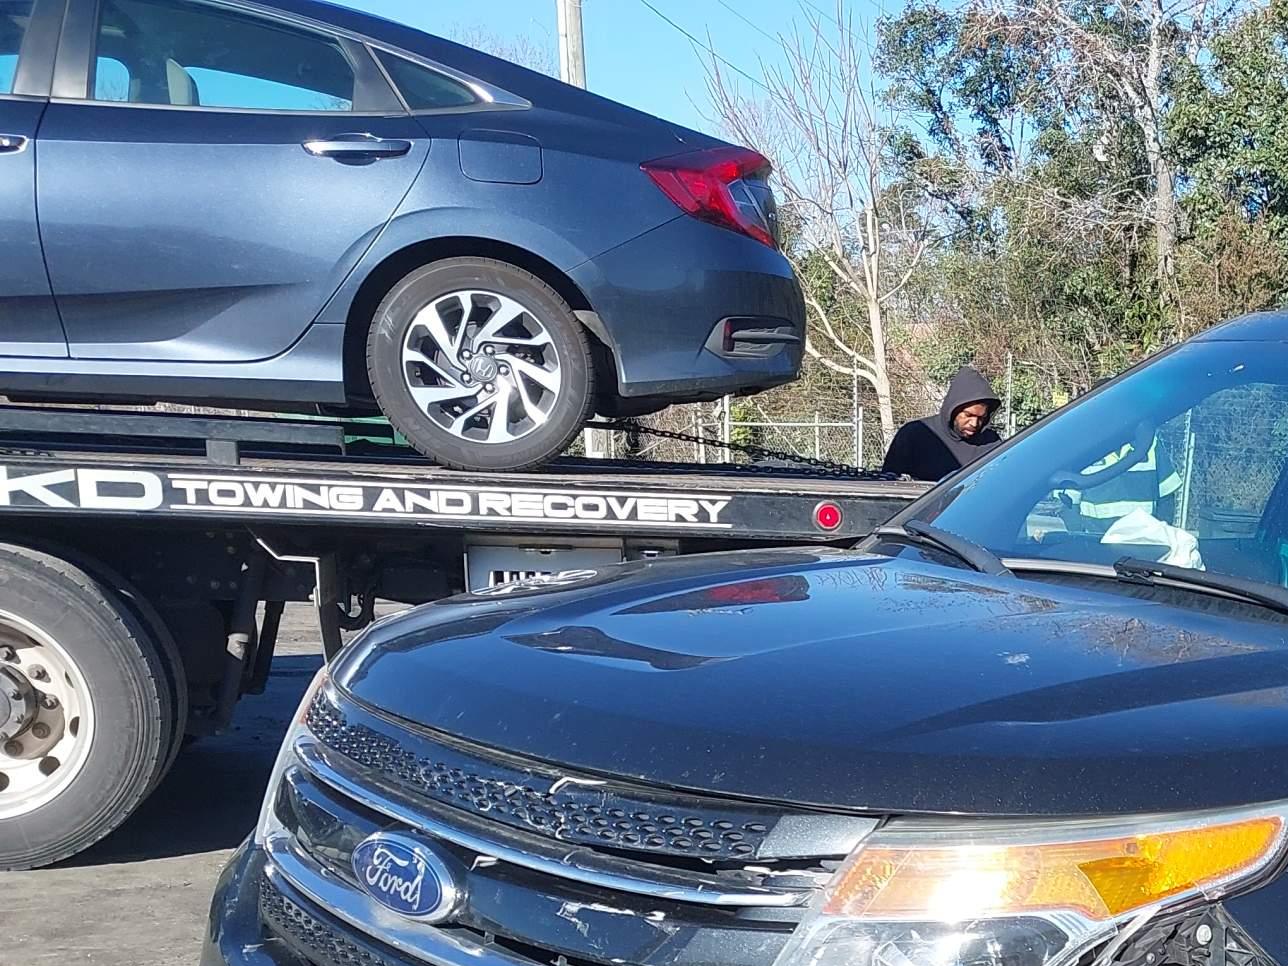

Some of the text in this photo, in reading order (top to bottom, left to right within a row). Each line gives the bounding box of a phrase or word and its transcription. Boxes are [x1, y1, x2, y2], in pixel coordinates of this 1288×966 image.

[171, 479, 364, 511] TOWING
[372, 487, 472, 515] AND
[478, 491, 729, 523] RECOVERY
[365, 847, 426, 911] Ford
